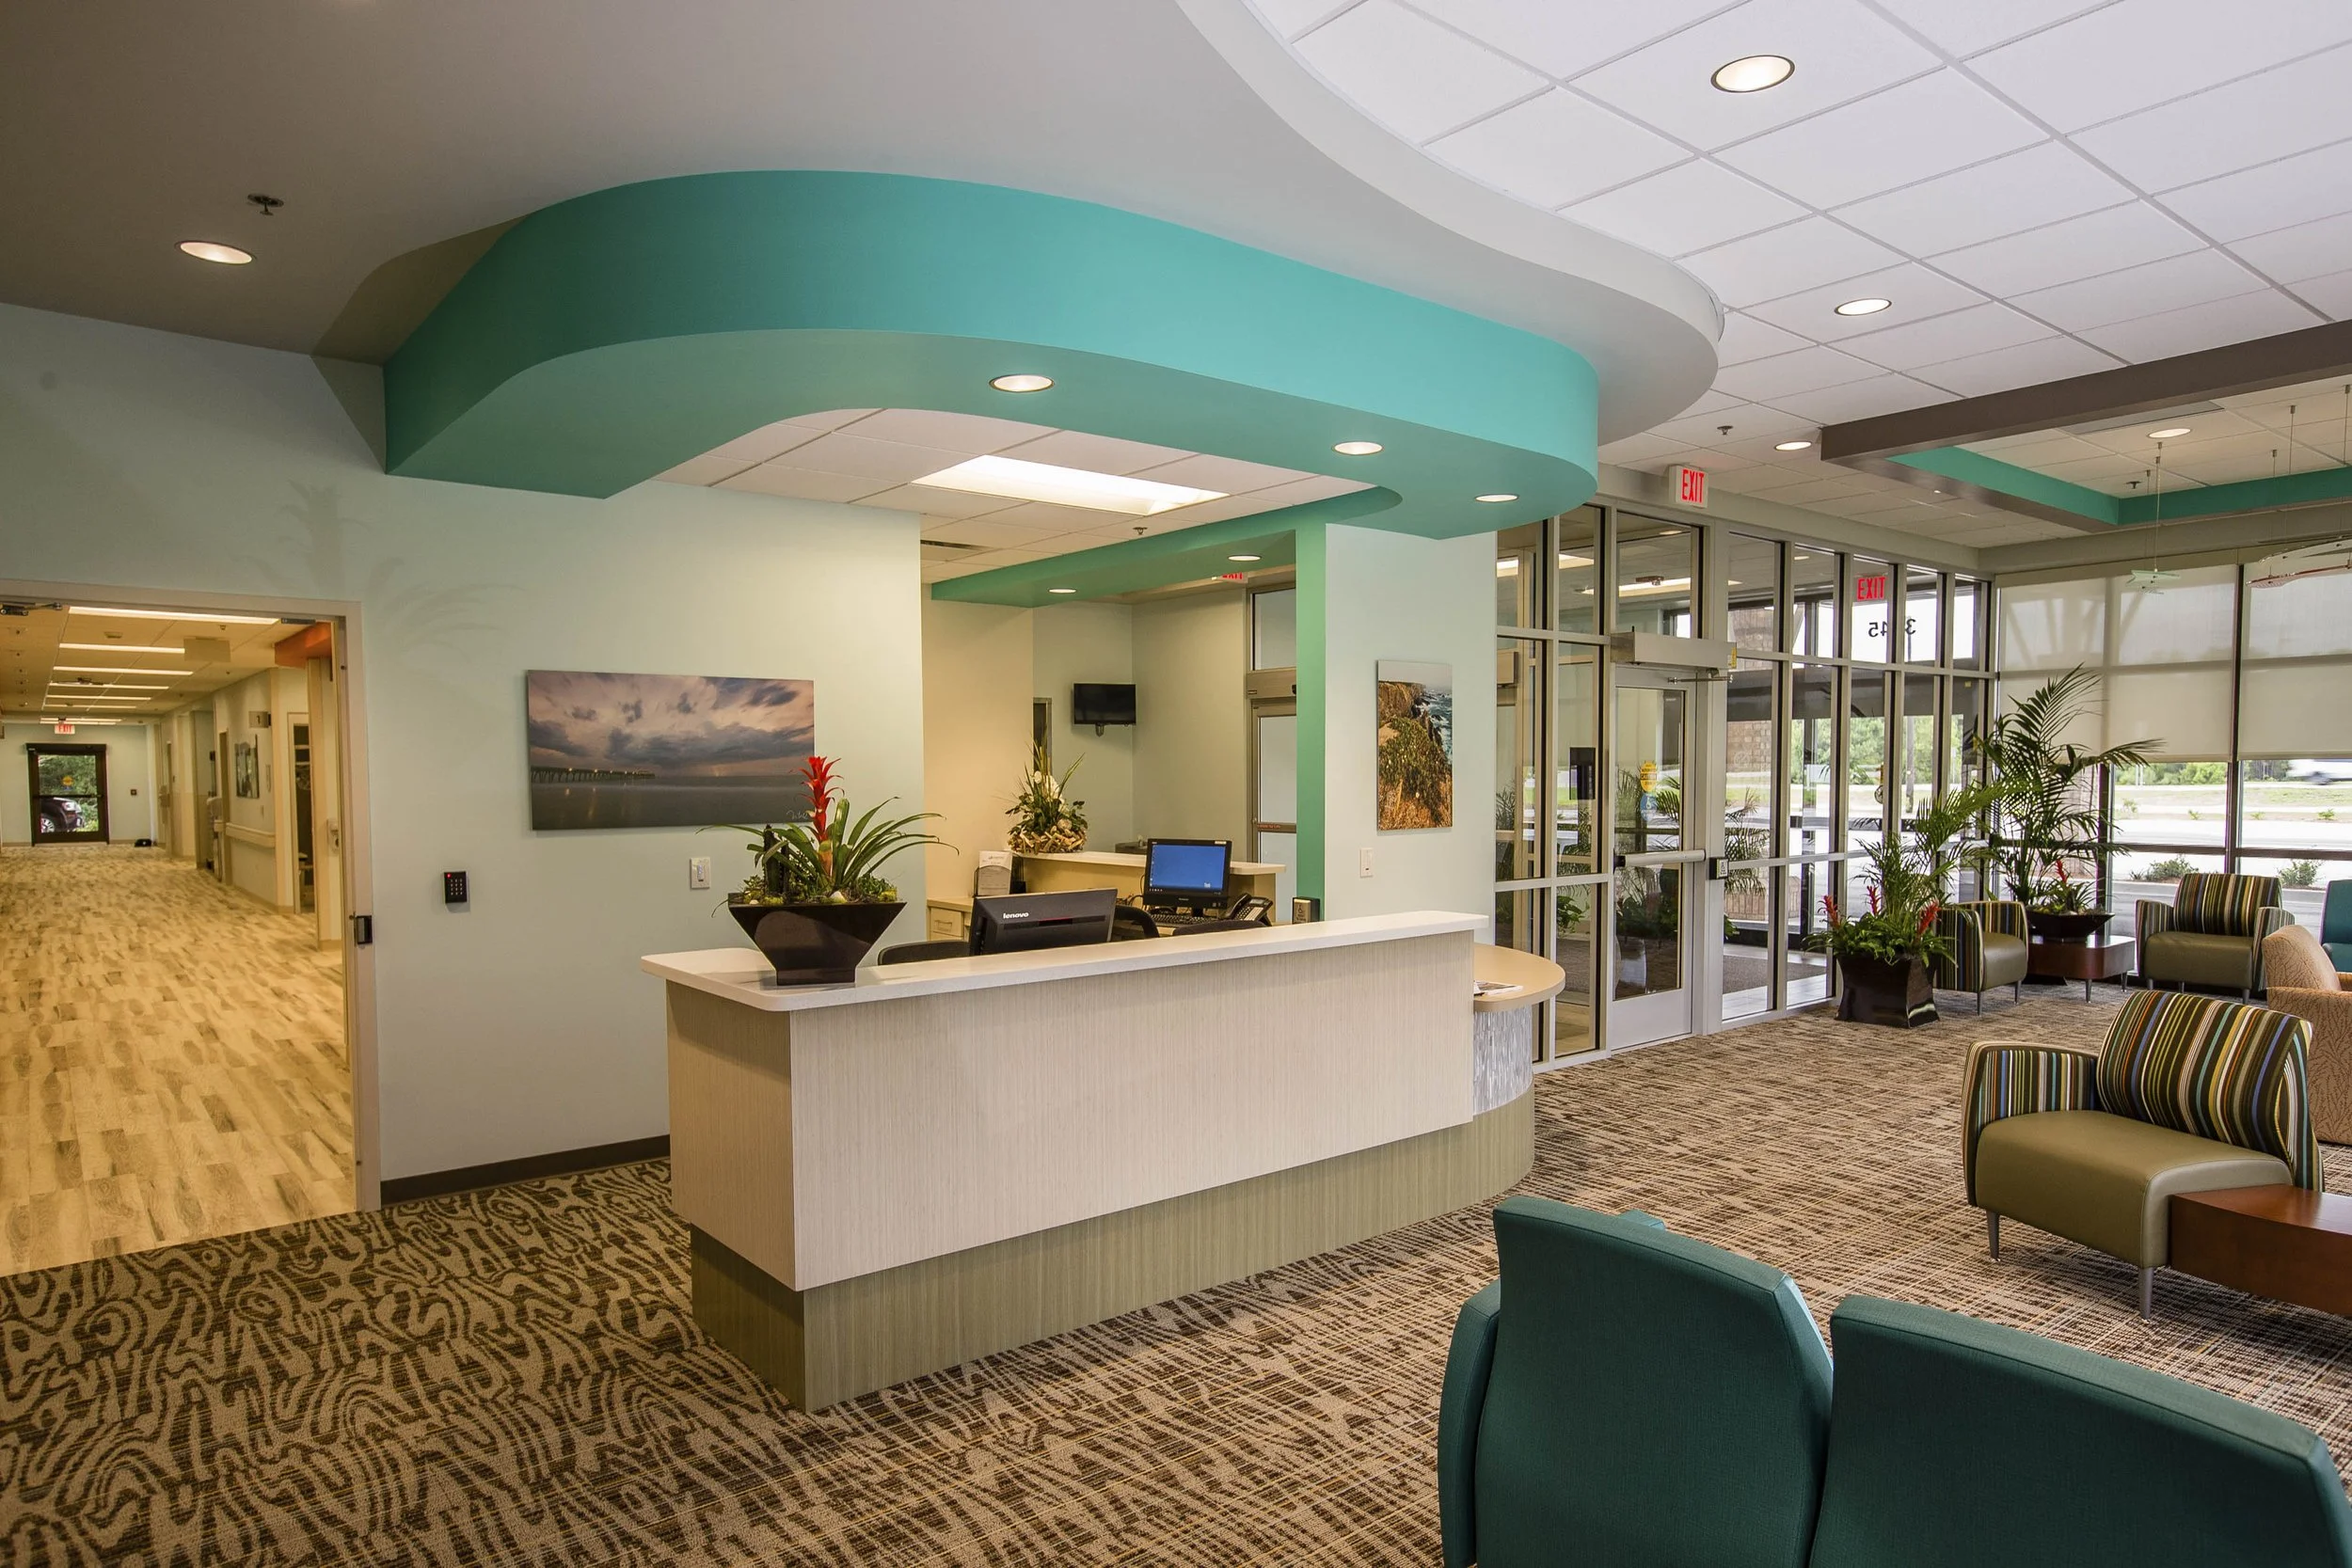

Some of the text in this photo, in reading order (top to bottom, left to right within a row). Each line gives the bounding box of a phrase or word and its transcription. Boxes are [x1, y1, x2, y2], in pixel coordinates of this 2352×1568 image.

[1681, 468, 1706, 503] EXIT
[1857, 577, 1885, 599] EXIT
[58, 723, 72, 733] EXIT
